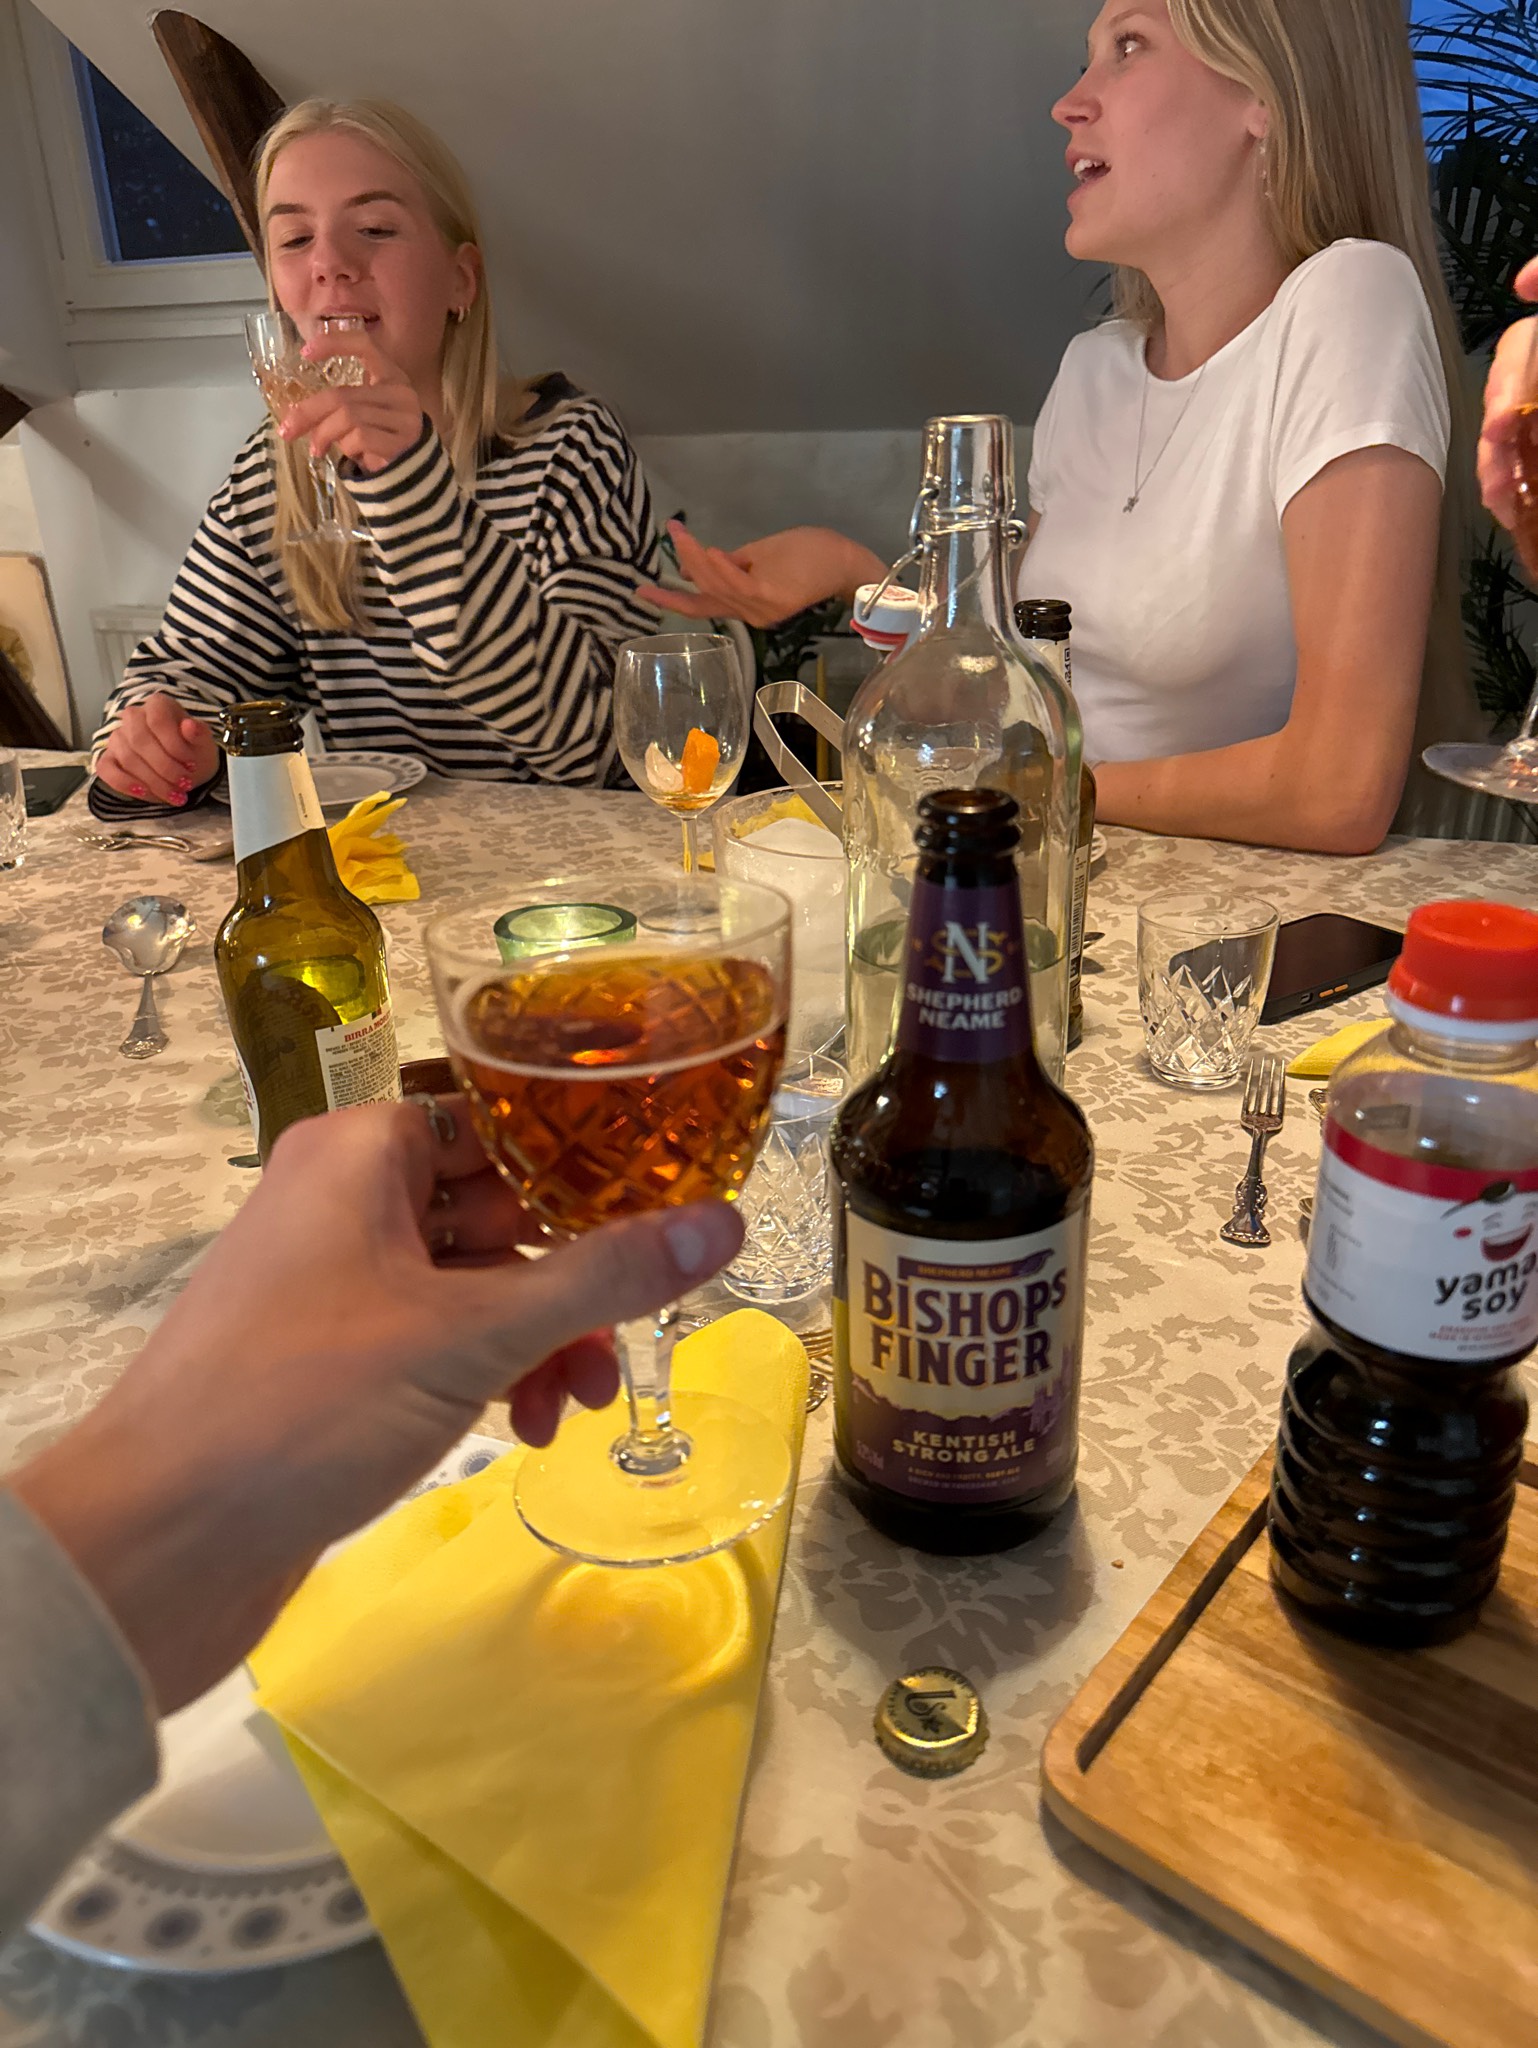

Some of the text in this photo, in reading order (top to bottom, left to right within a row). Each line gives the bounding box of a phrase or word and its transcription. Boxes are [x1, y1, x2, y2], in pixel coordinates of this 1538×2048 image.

[906, 982, 1023, 1011] SHEPHERD
[918, 1007, 1006, 1030] NEAME
[344, 1025, 374, 1042] BIRRA
[1433, 1251, 1537, 1306] yama
[863, 1260, 1067, 1337] BISHOPS
[1461, 1280, 1528, 1321] soy
[871, 1323, 1053, 1387] FINGER
[892, 1438, 989, 1463] STRONG
[991, 1437, 1035, 1460] ALE
[913, 1429, 1016, 1449] KENTISH
